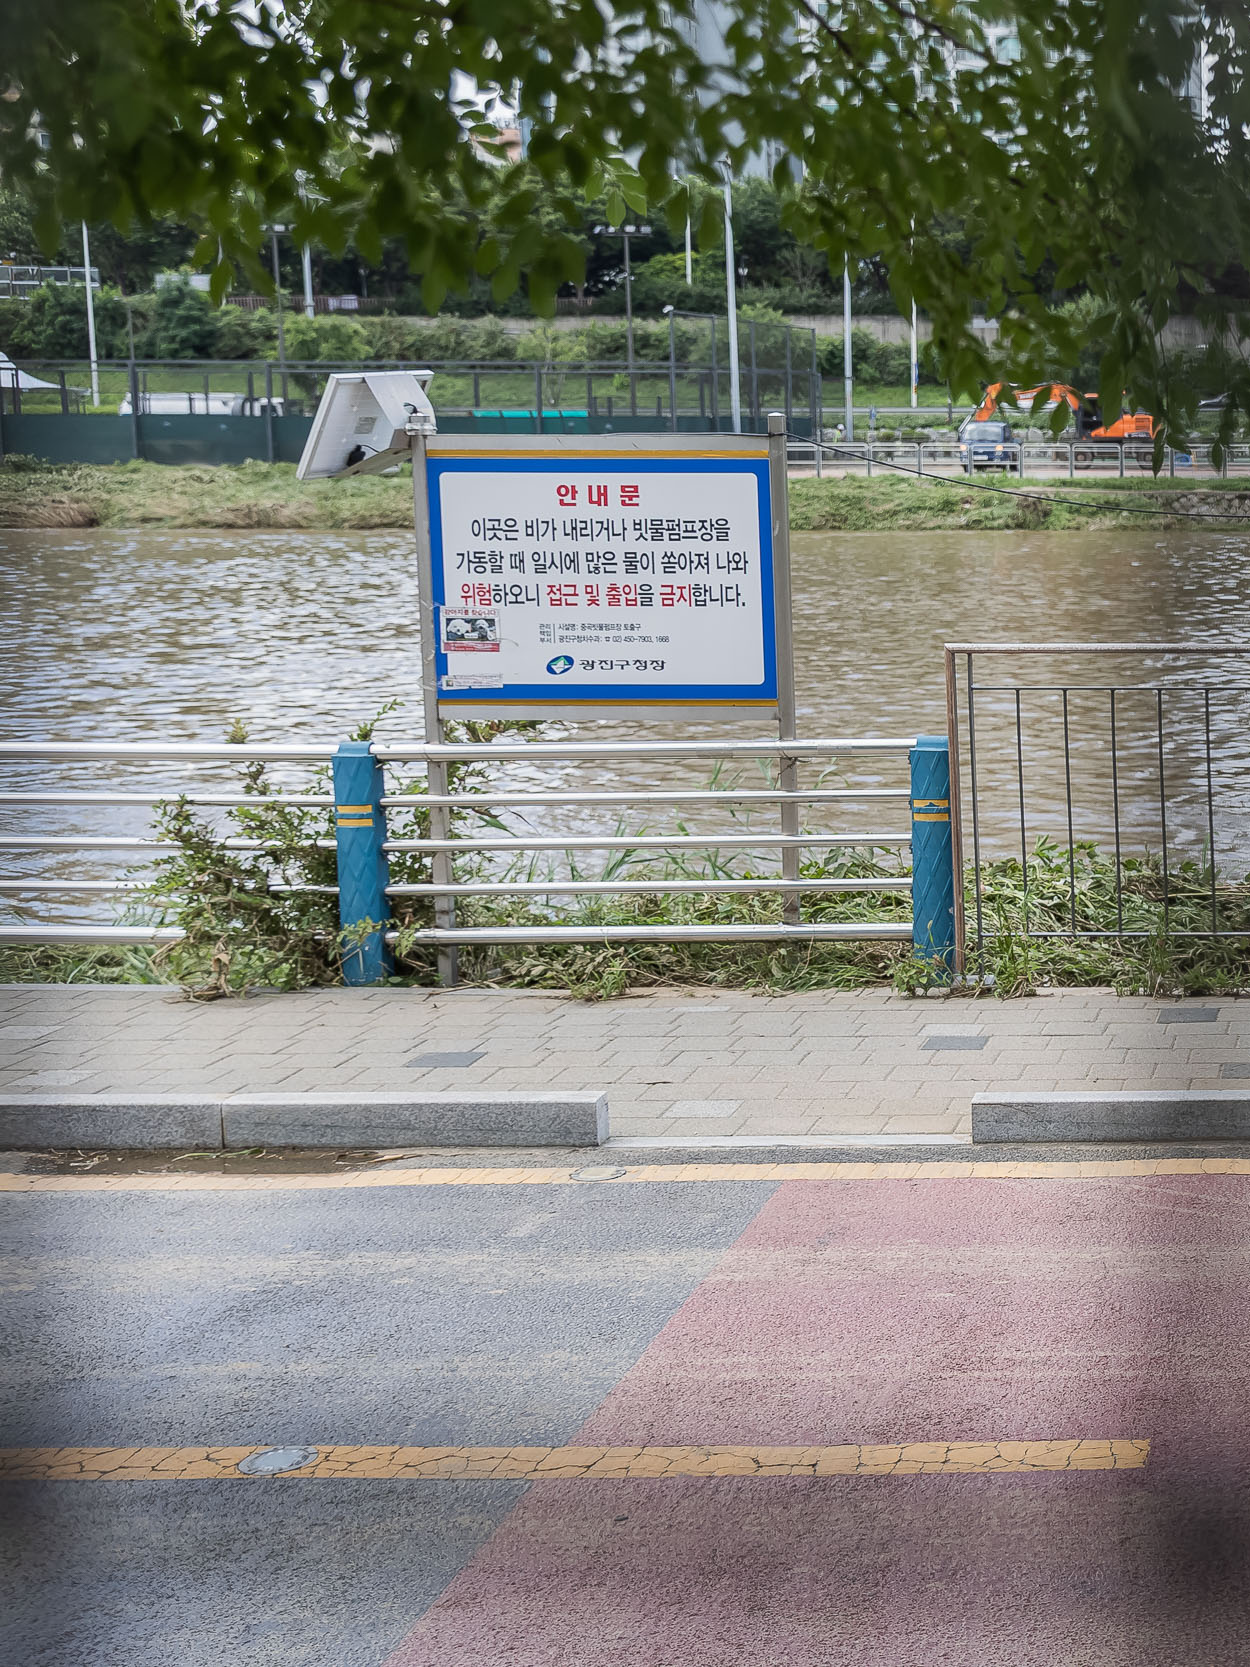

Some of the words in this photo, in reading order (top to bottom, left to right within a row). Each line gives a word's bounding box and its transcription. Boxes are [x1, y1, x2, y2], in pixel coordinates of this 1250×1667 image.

[471, 517, 520, 542] 이곳은
[525, 517, 557, 542] 비가
[563, 517, 628, 543] 내리거나
[633, 517, 731, 542] 빗물펌프장을
[456, 550, 504, 575] 가동할
[510, 551, 526, 575] 때
[531, 550, 580, 575] 일시에
[585, 550, 618, 575] 많은
[623, 550, 656, 575] 물이
[661, 550, 710, 575] 쏟아져
[715, 550, 749, 575] 나와
[460, 583, 540, 607] 위험하오니
[546, 583, 579, 607] 접근
[584, 583, 601, 607] 및
[605, 583, 655, 607] 출입을
[659, 583, 746, 608] 금지합니다.
[579, 659, 667, 672] 광진구청장
